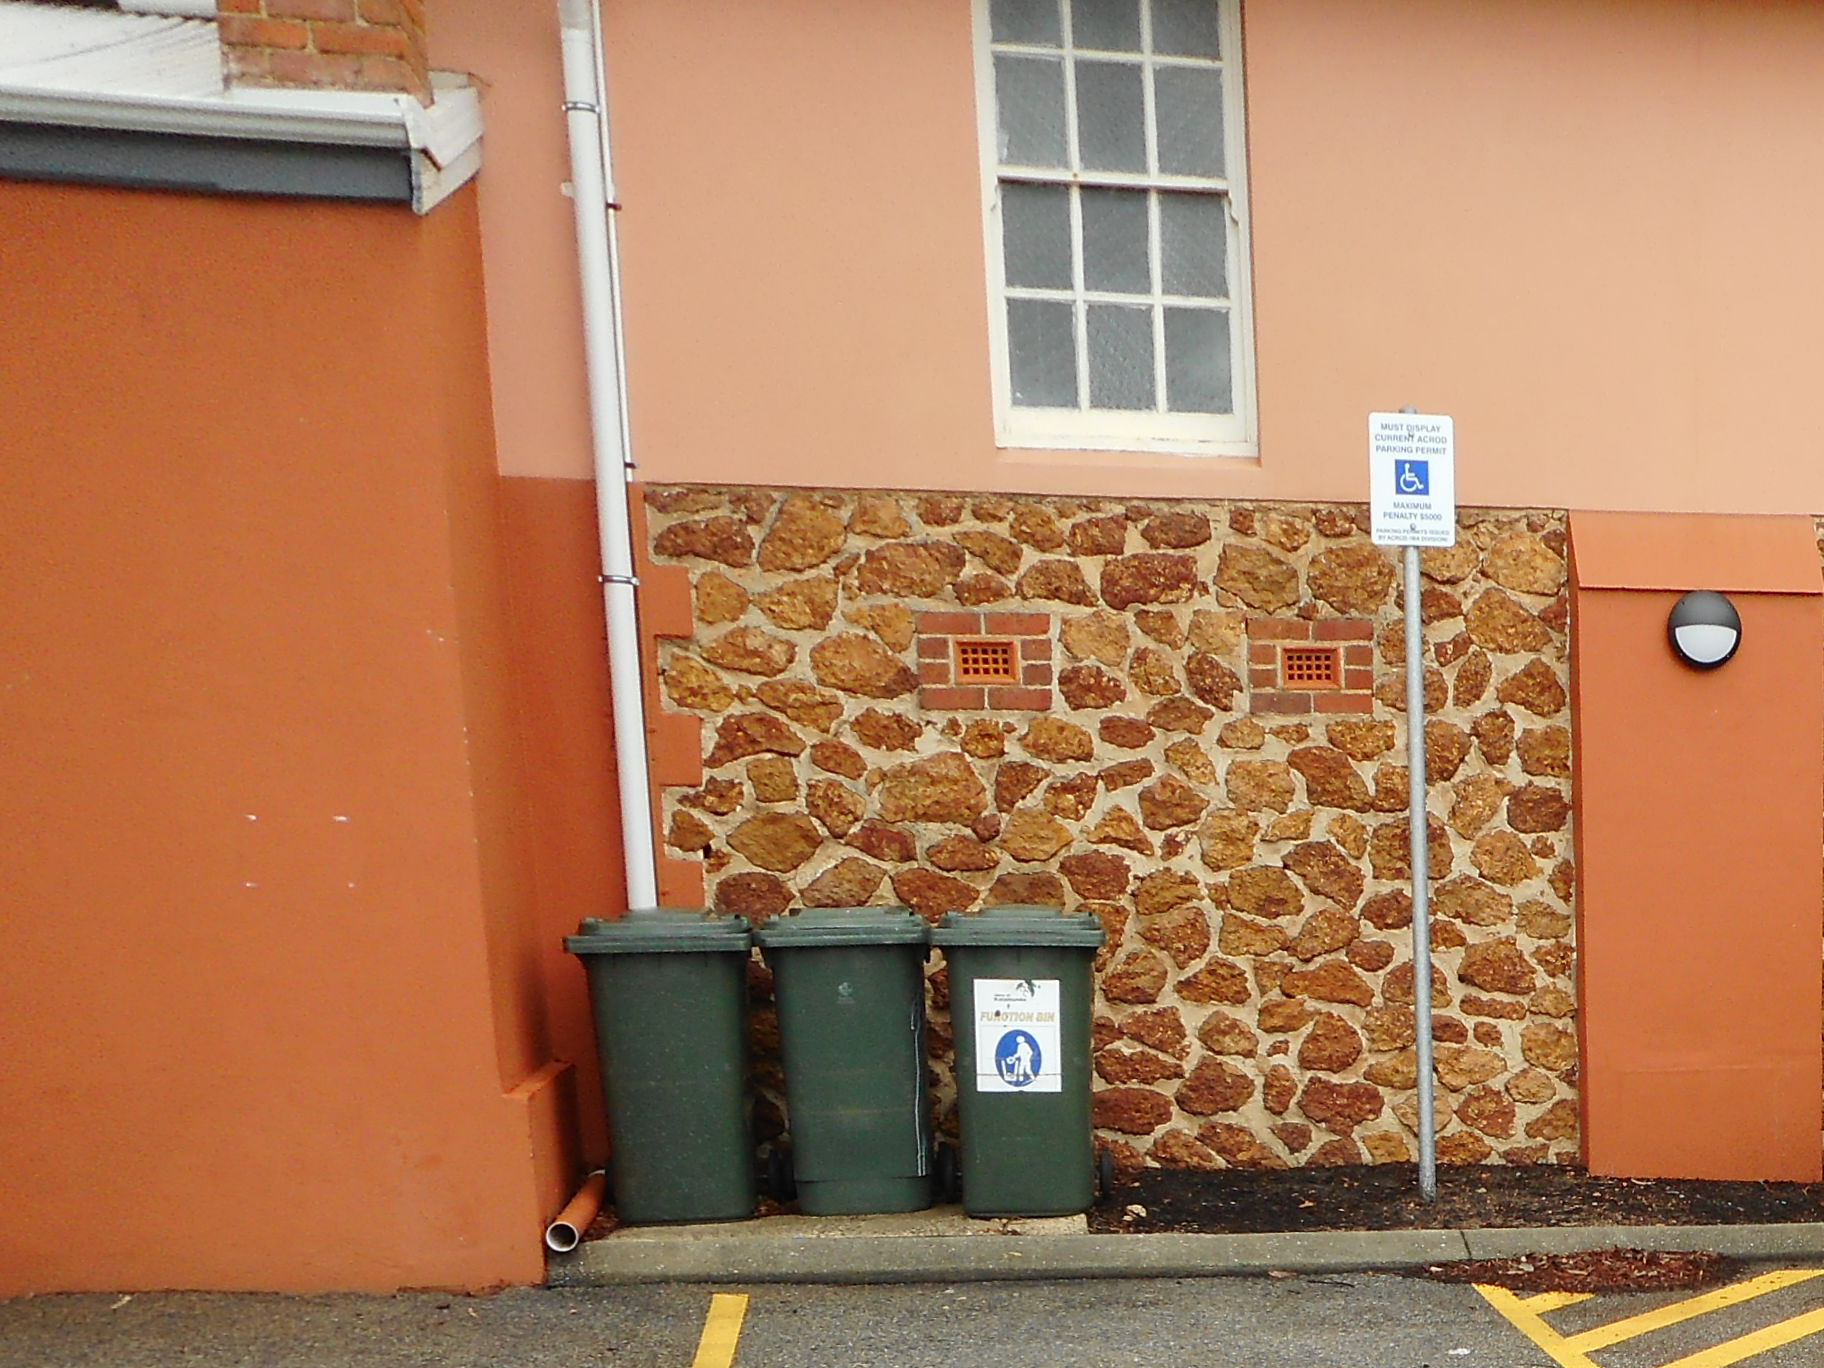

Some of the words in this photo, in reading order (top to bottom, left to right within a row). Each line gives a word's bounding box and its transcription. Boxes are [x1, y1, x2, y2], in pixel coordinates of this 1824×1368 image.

[1380, 423, 1404, 432] MUST
[1406, 424, 1441, 433] DISPLAY
[1375, 434, 1415, 444] CURRENT
[1417, 435, 1448, 445] ACROD
[1376, 445, 1413, 454] PARKING
[1415, 446, 1447, 456] PERMIT
[1393, 501, 1432, 510] MAXIMUM
[1383, 511, 1418, 520] PENALTY
[1420, 513, 1443, 521] $5000
